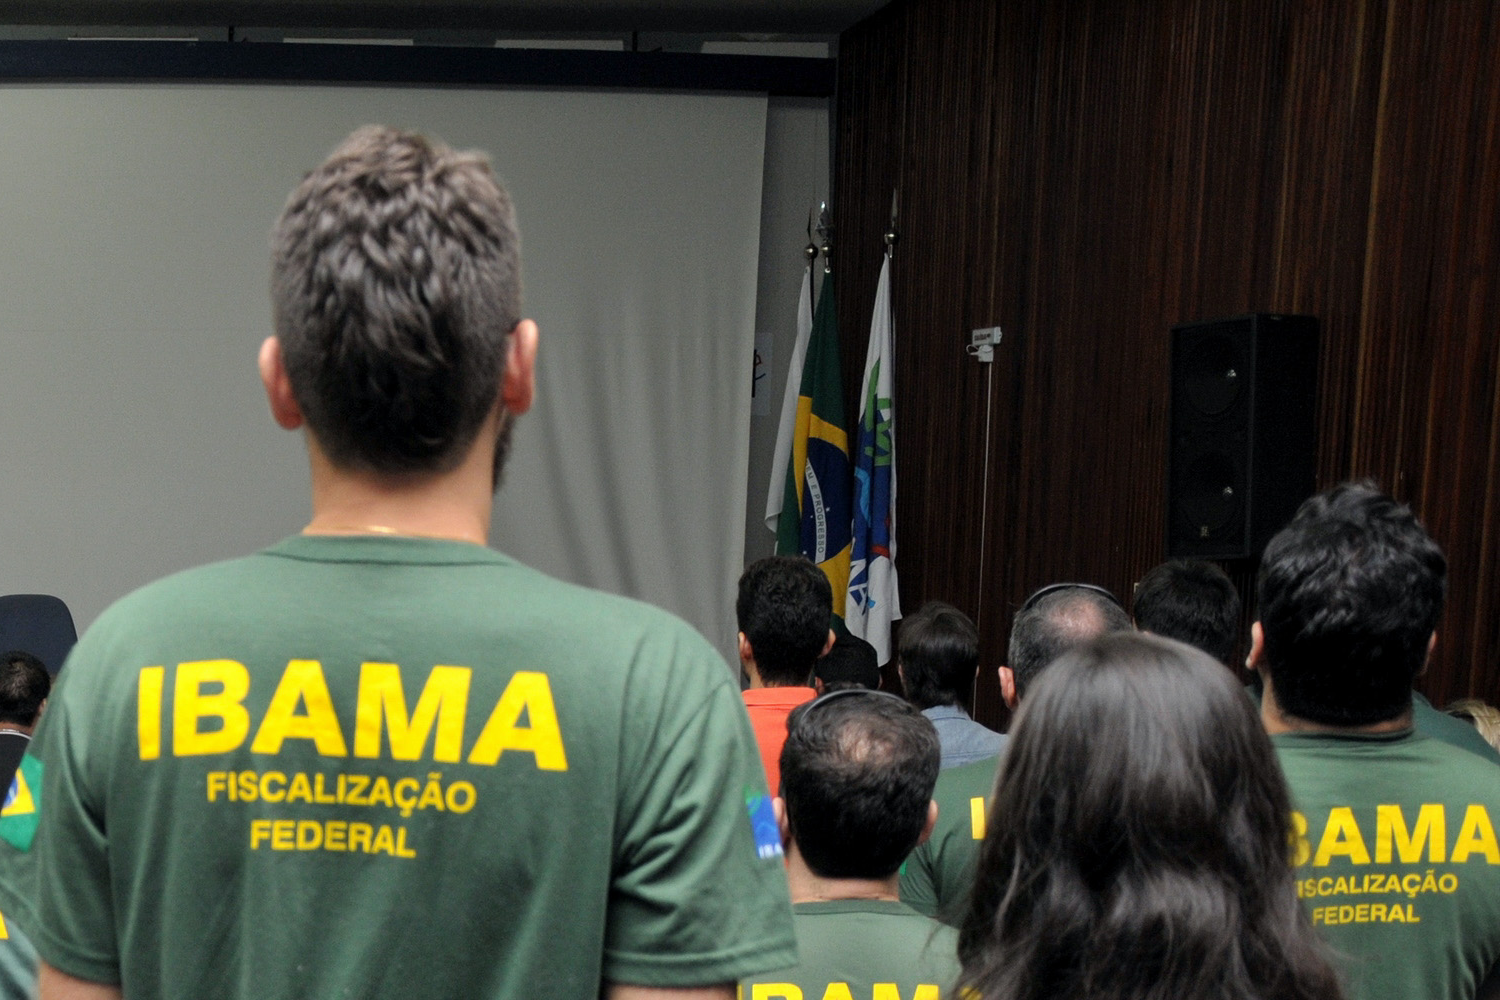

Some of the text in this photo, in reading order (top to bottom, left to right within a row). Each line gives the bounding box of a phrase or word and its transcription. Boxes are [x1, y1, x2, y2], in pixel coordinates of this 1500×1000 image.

[814, 493, 825, 553] PROGRESSO
[137, 659, 569, 771] IBAMA
[206, 770, 477, 817] FISCALIZAÇÃO
[250, 820, 417, 858] FEDERAL
[758, 843, 785, 859] IBA
[1287, 803, 1500, 868] AMA
[1296, 868, 1459, 899] ISCALIZAÇÃO
[1312, 903, 1421, 927] FEDERAL
